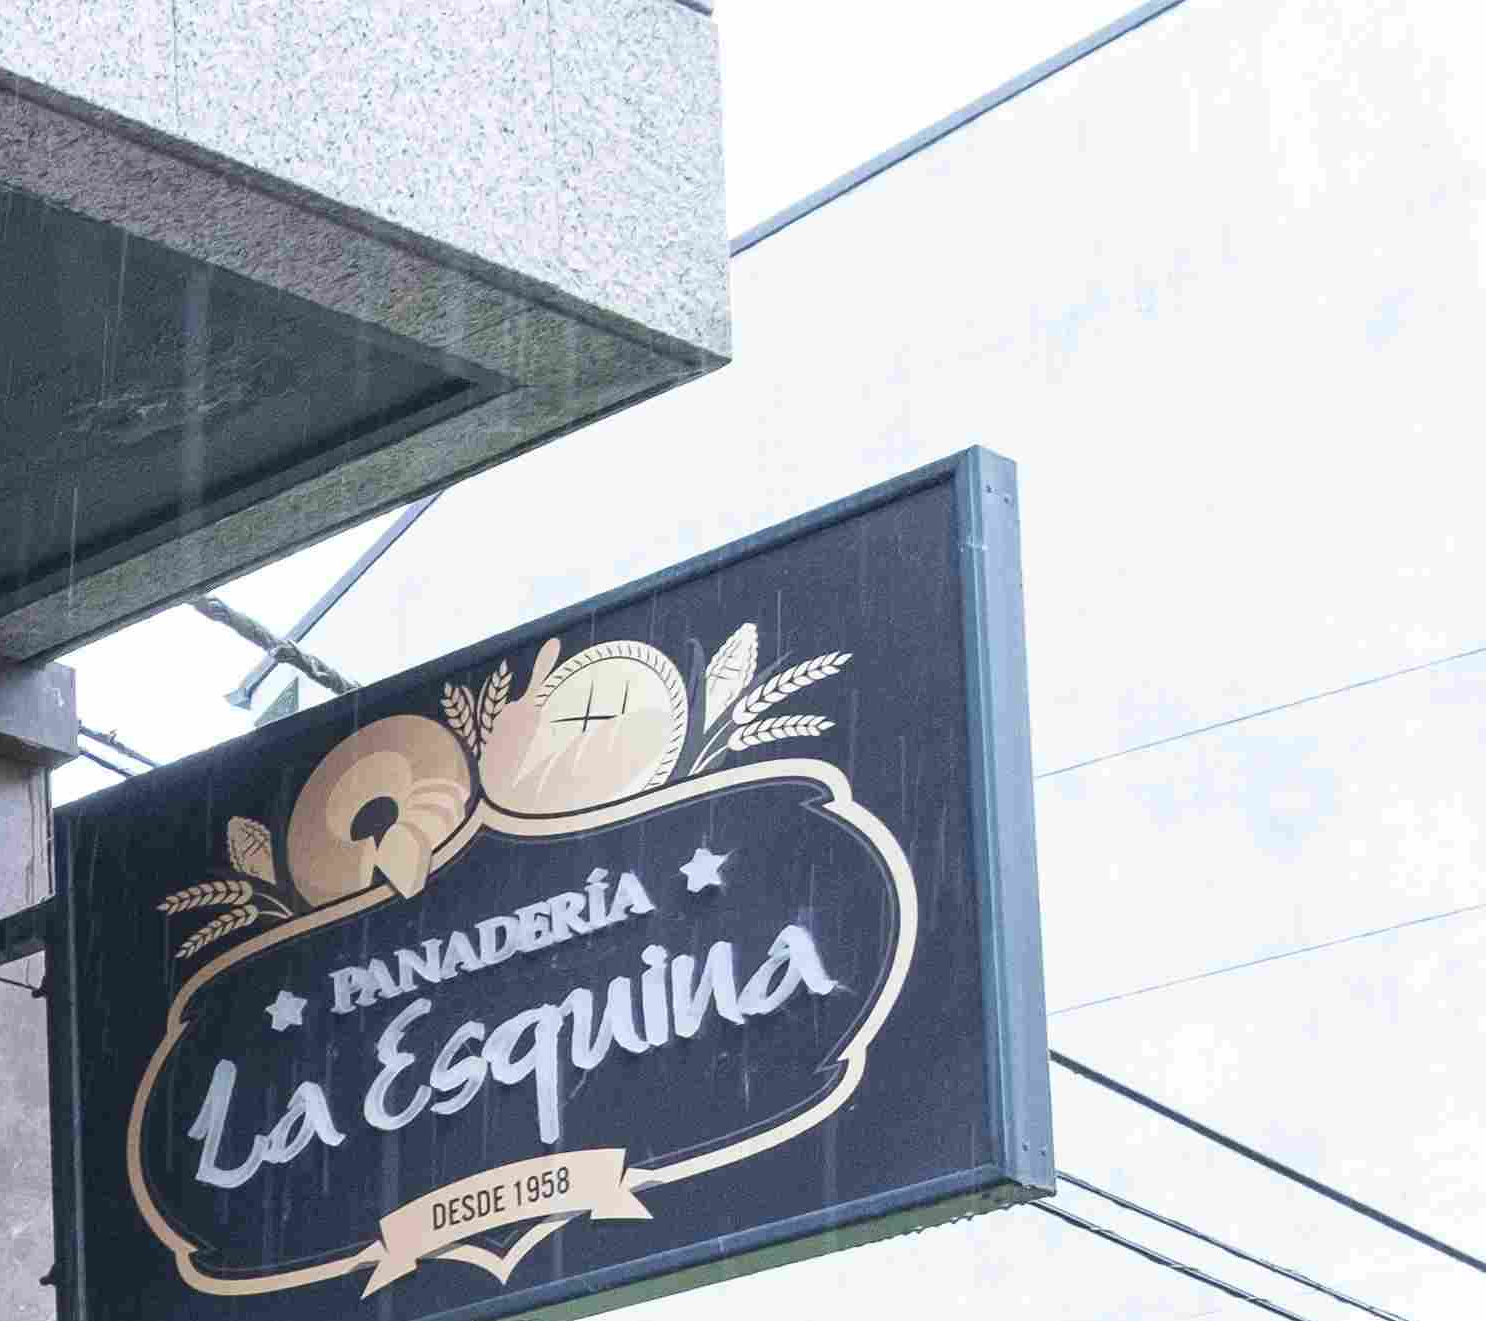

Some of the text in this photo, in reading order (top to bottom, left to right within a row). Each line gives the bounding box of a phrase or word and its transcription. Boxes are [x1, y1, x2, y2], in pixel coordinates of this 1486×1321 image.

[328, 868, 656, 1015] PANADERÍA
[187, 924, 839, 1189] La Esquina
[432, 1166, 570, 1231] DESDE 1958
